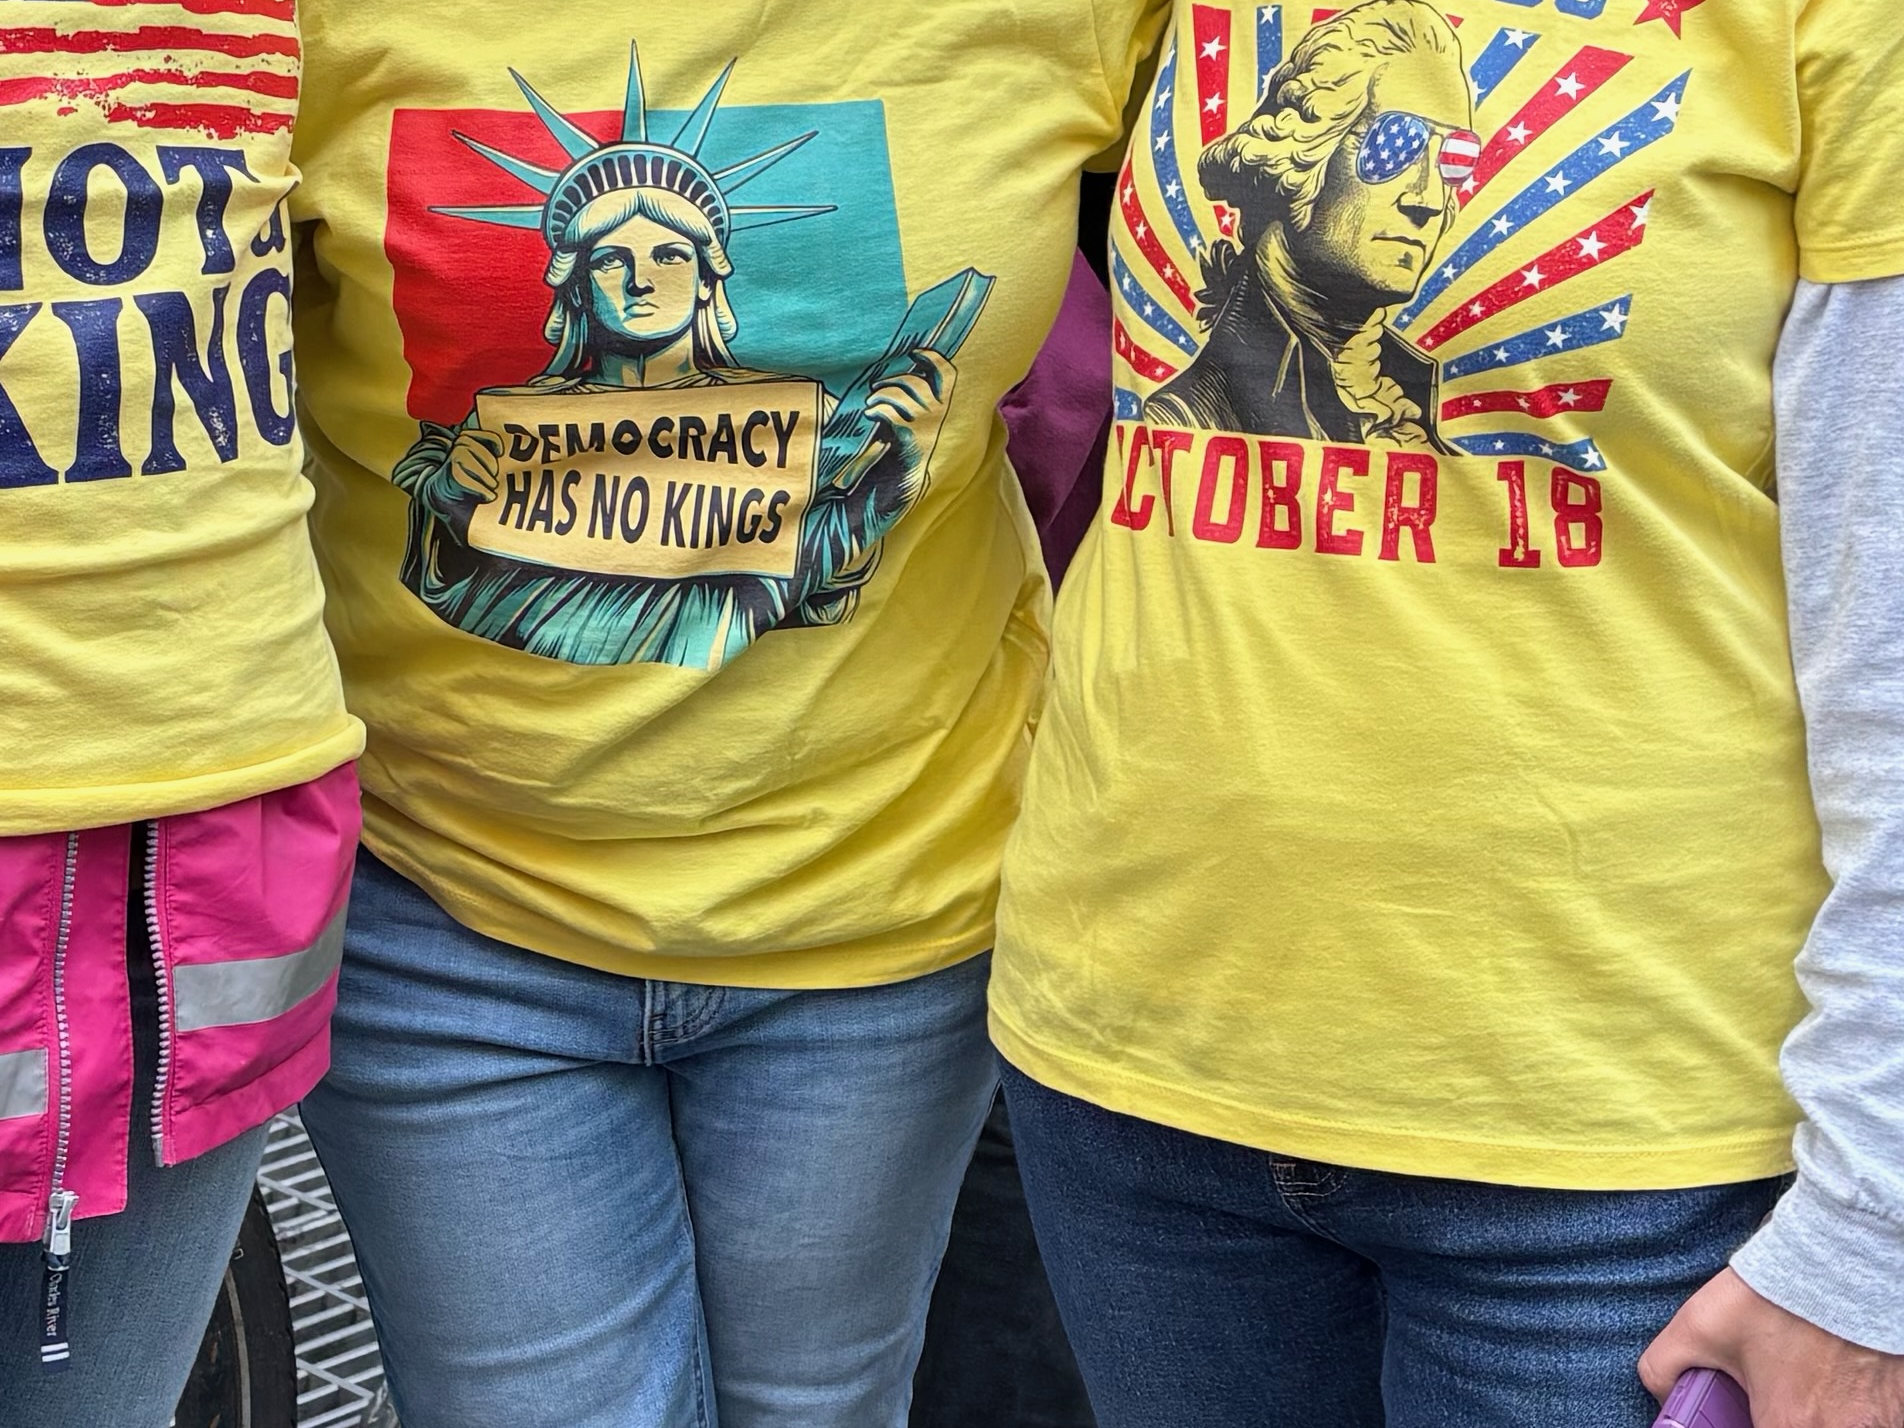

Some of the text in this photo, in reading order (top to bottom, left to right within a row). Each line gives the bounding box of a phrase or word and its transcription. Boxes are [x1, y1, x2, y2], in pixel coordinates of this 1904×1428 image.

[504, 410, 800, 470] DEMOCRACY
[498, 471, 791, 549] HAS NO KINGS
[1111, 424, 1605, 570] CTOBER 18
[45, 1306, 61, 1337] River
